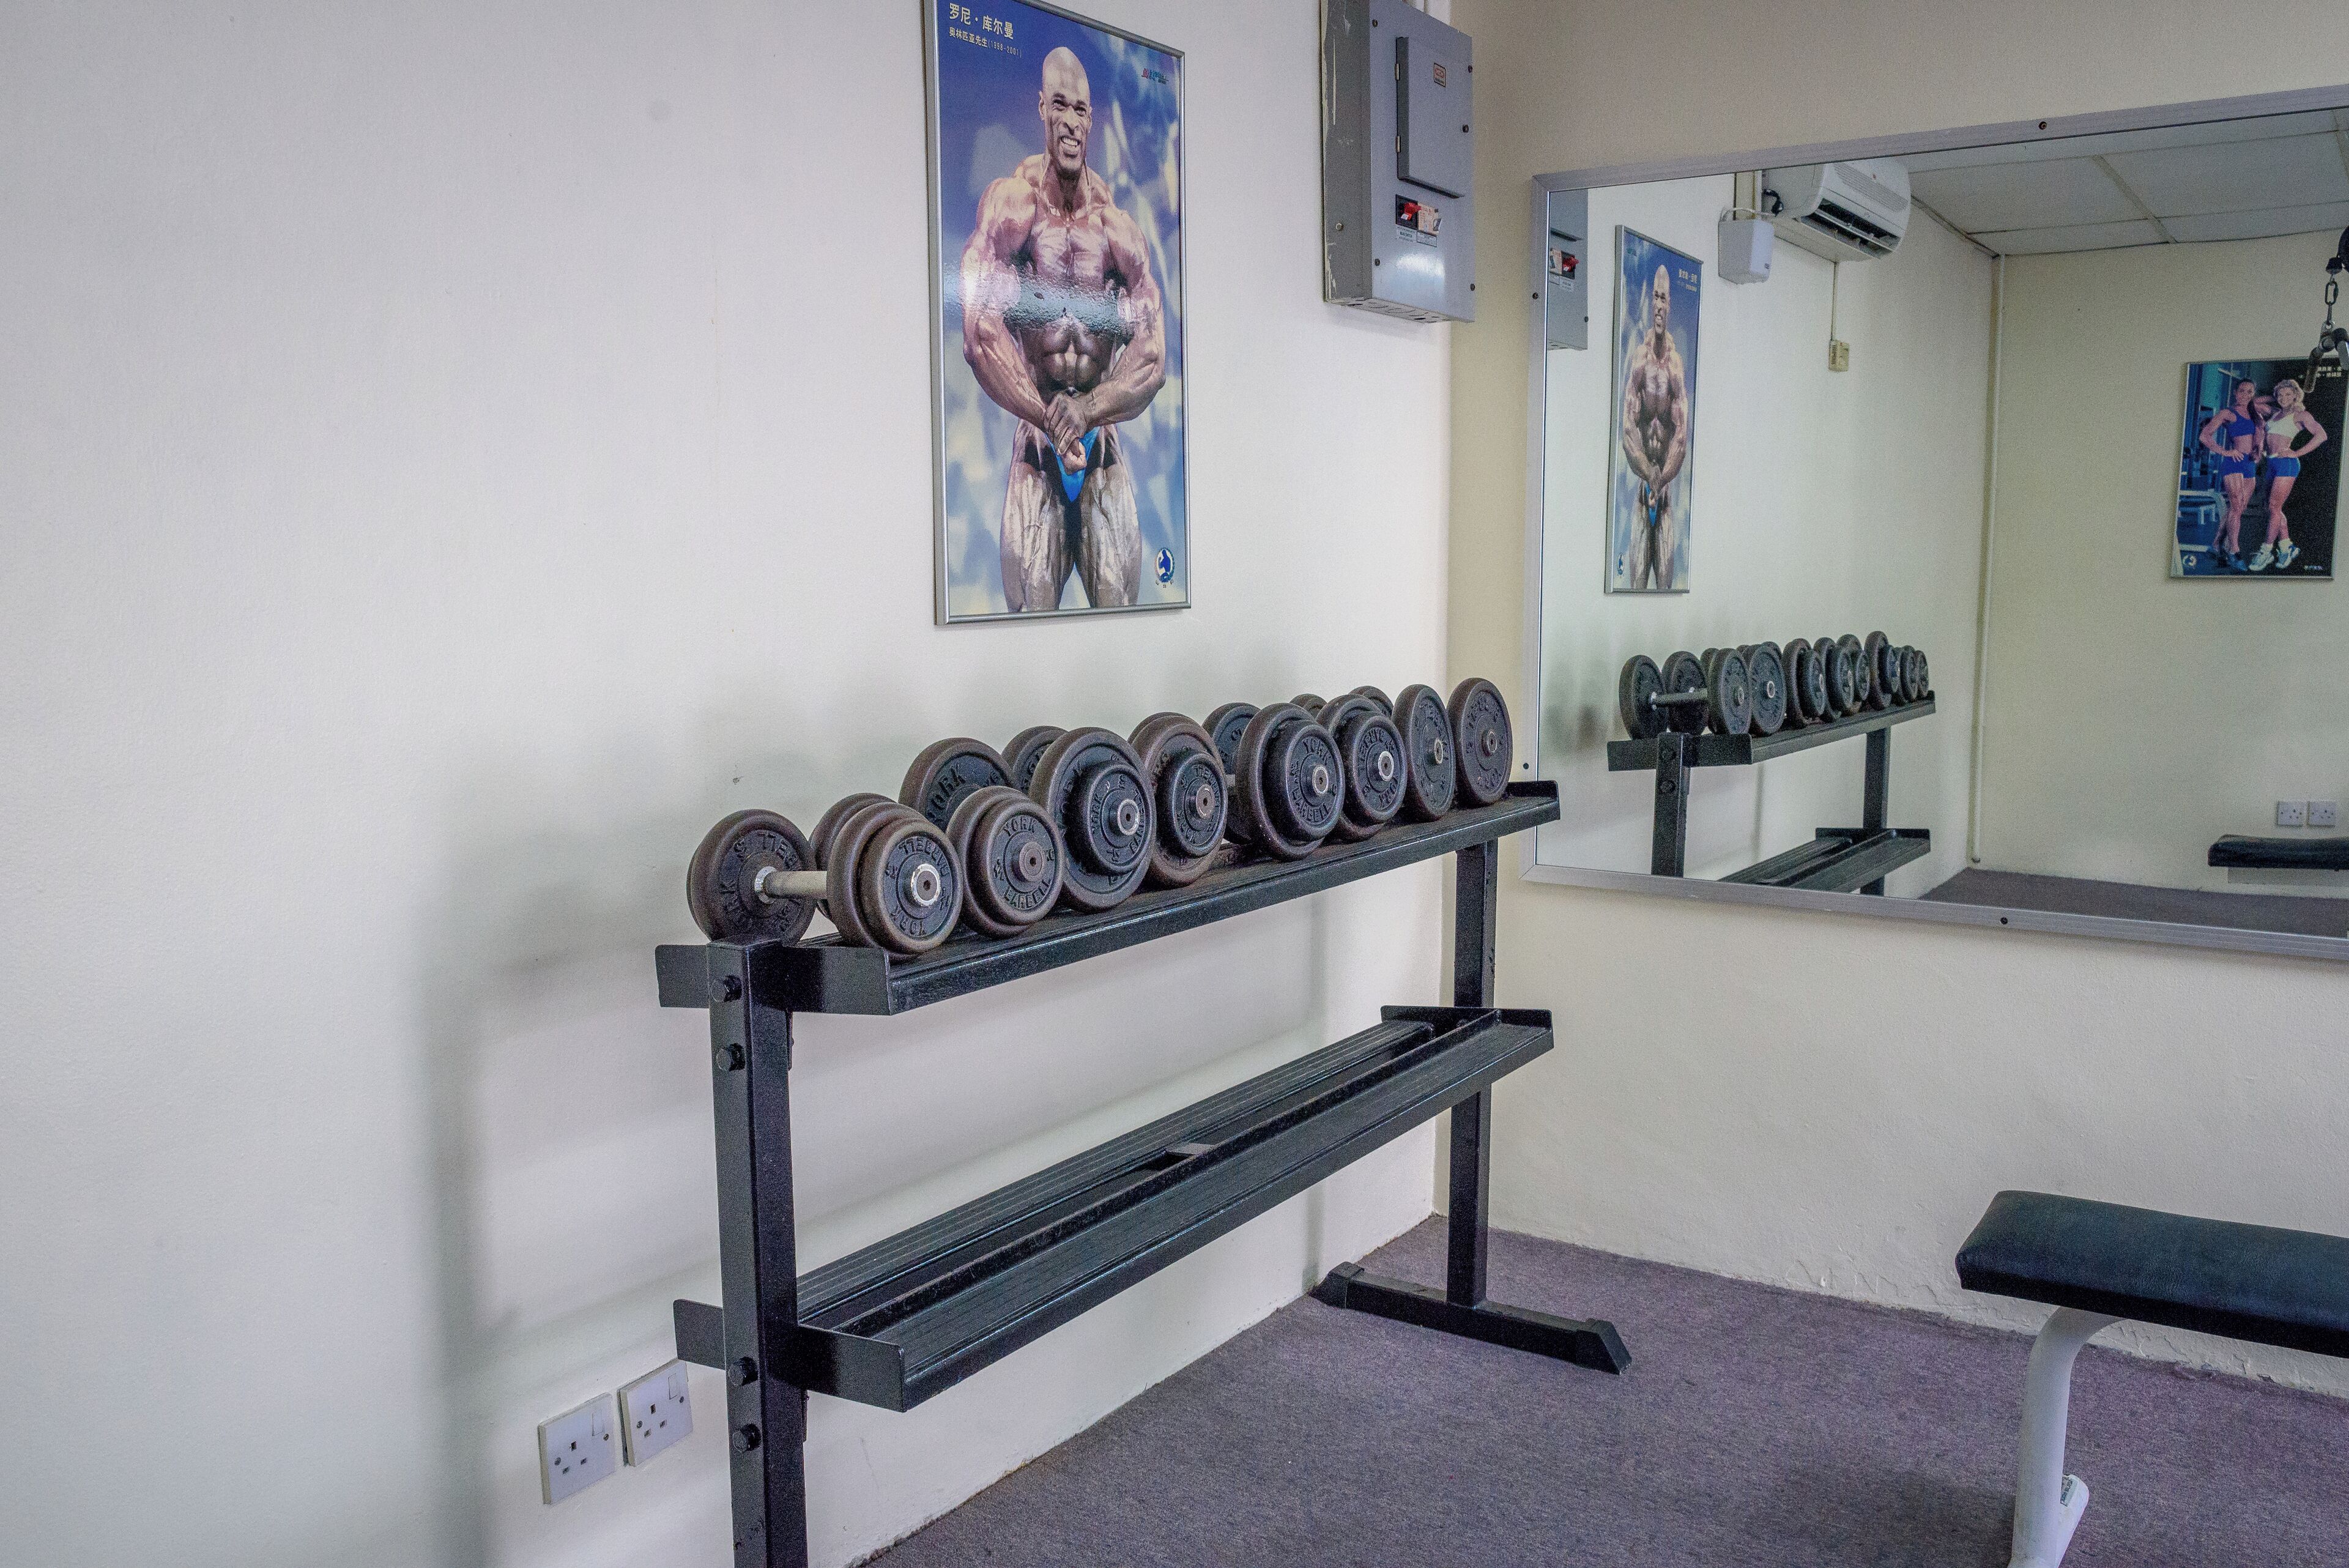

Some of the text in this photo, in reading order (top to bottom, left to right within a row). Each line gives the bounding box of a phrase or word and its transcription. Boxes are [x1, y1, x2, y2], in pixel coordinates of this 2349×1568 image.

[949, 2, 1014, 40] 罗尼·库尔曼
[1003, 816, 1038, 837] YORK
[898, 836, 949, 878] BARBELL
[1003, 879, 1053, 909] BARBELL
[889, 905, 927, 937] YORK
